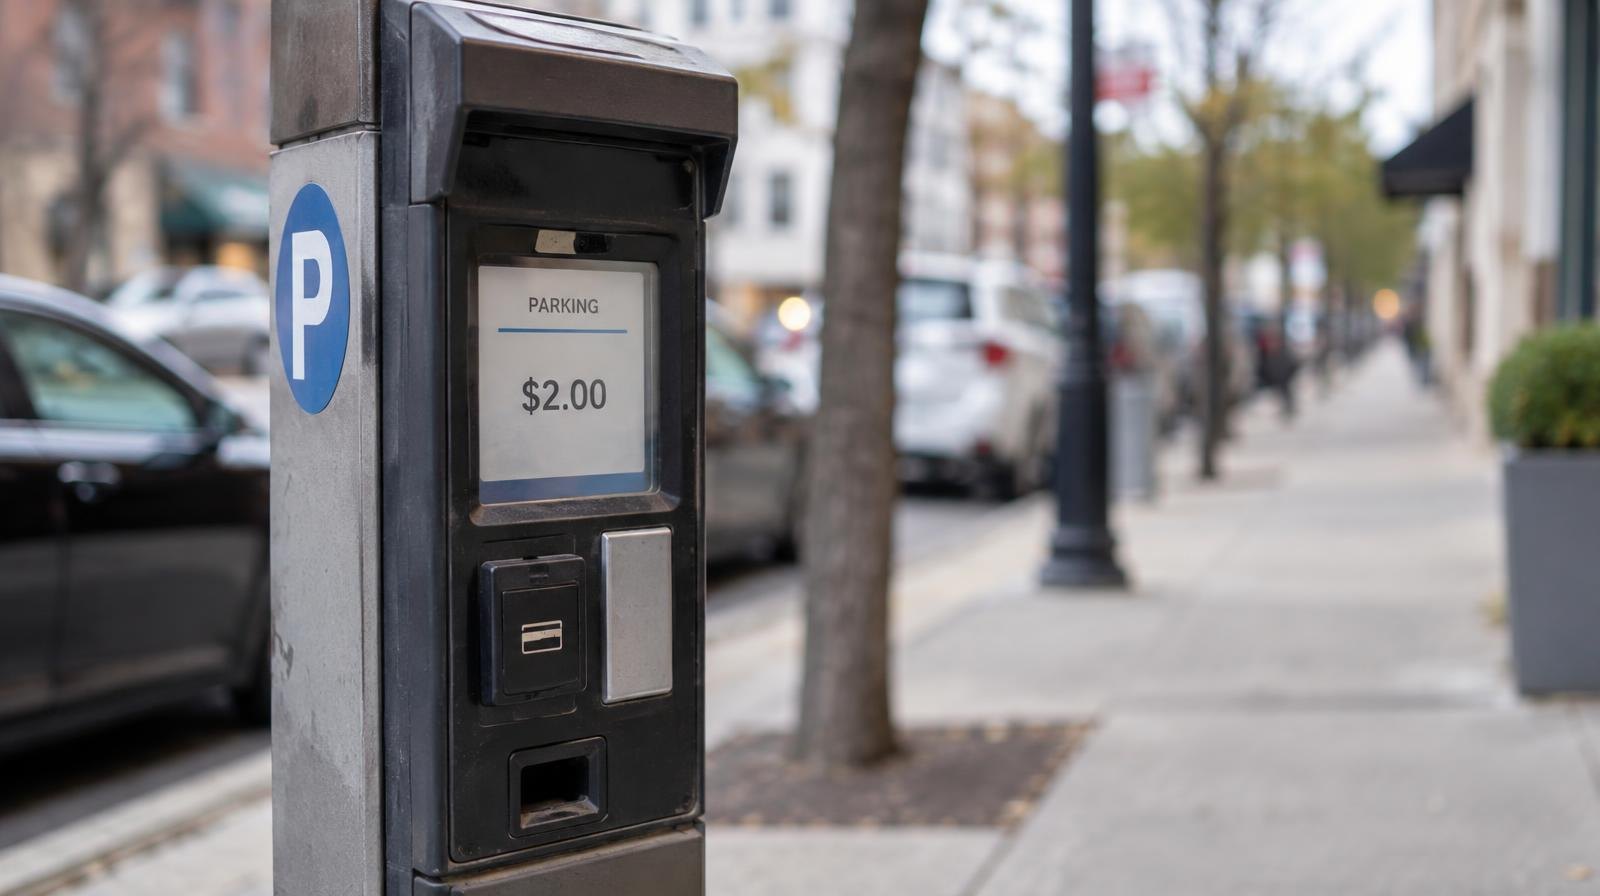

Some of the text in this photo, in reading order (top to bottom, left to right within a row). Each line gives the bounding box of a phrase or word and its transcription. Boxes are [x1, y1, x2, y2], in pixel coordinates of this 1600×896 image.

[291, 230, 333, 380] P
[528, 297, 599, 314] PARKING
[522, 376, 607, 416] $2.00
